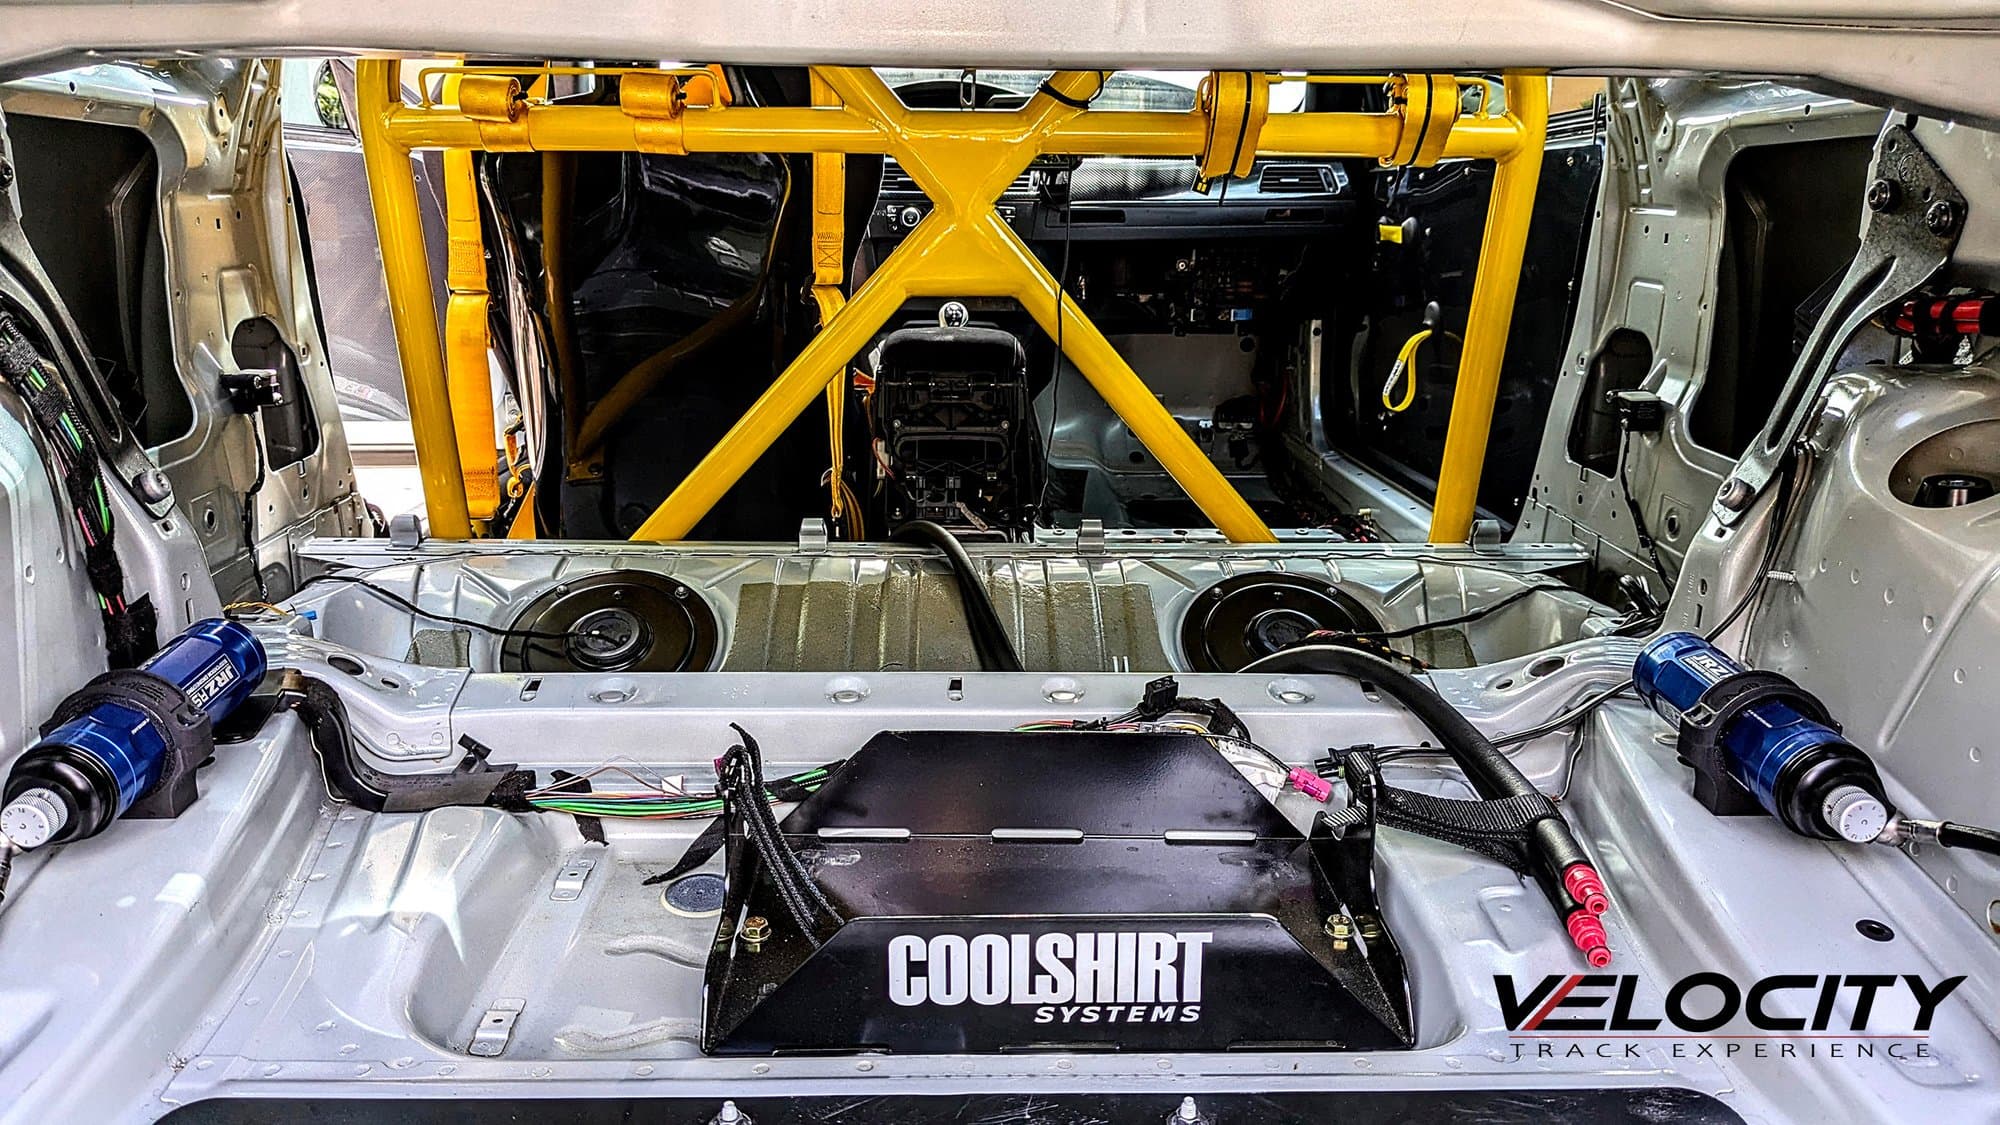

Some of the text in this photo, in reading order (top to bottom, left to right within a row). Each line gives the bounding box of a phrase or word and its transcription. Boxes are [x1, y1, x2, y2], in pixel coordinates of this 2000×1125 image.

[1692, 654, 1730, 676] JRZ
[888, 932, 1214, 1007] COOLSHIRT
[1033, 1005, 1201, 1024] SYSTEMS
